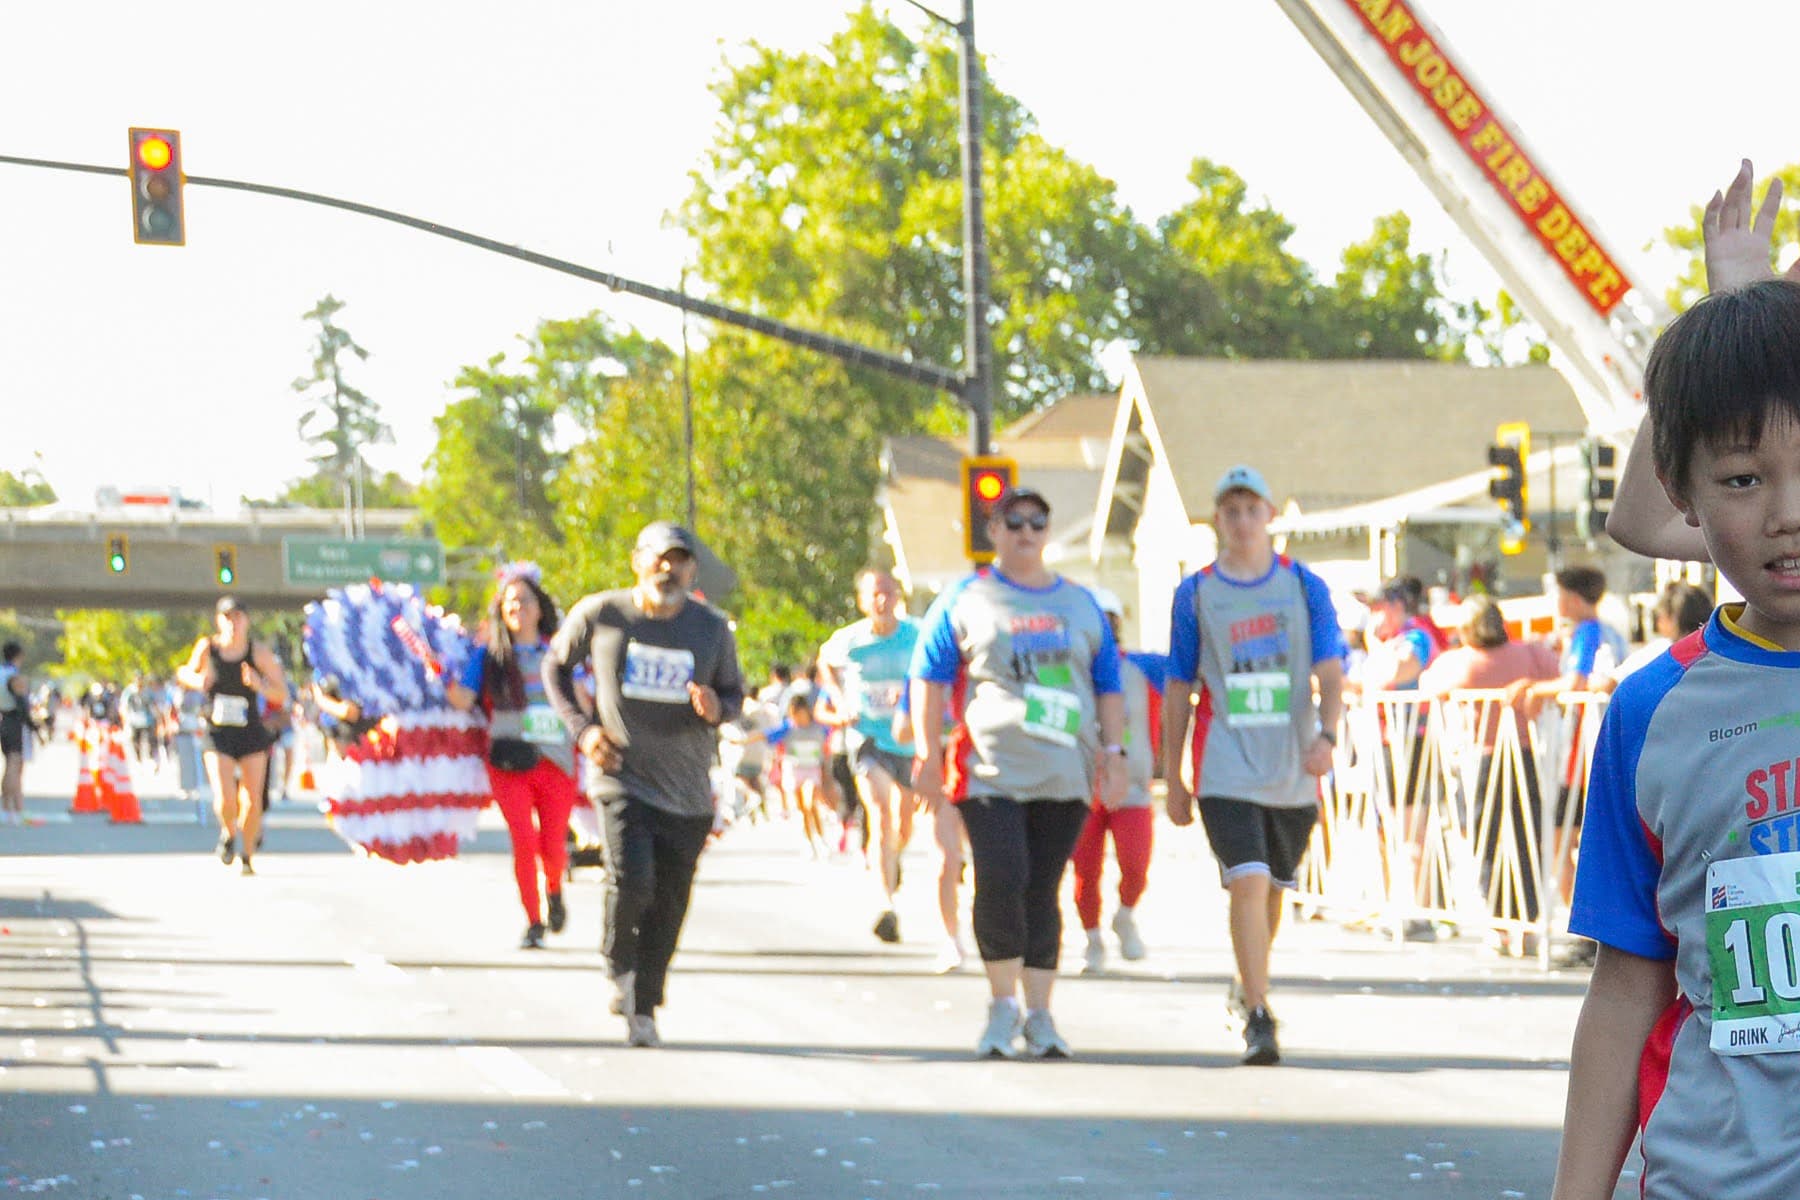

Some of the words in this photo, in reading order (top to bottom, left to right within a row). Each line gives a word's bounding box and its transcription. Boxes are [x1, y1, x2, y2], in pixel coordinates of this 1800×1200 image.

[1358, 0, 1413, 42] AN
[1399, 39, 1482, 130] JOSE
[1470, 120, 1549, 213] FIRE
[1730, 1027, 1769, 1046] DRINK
